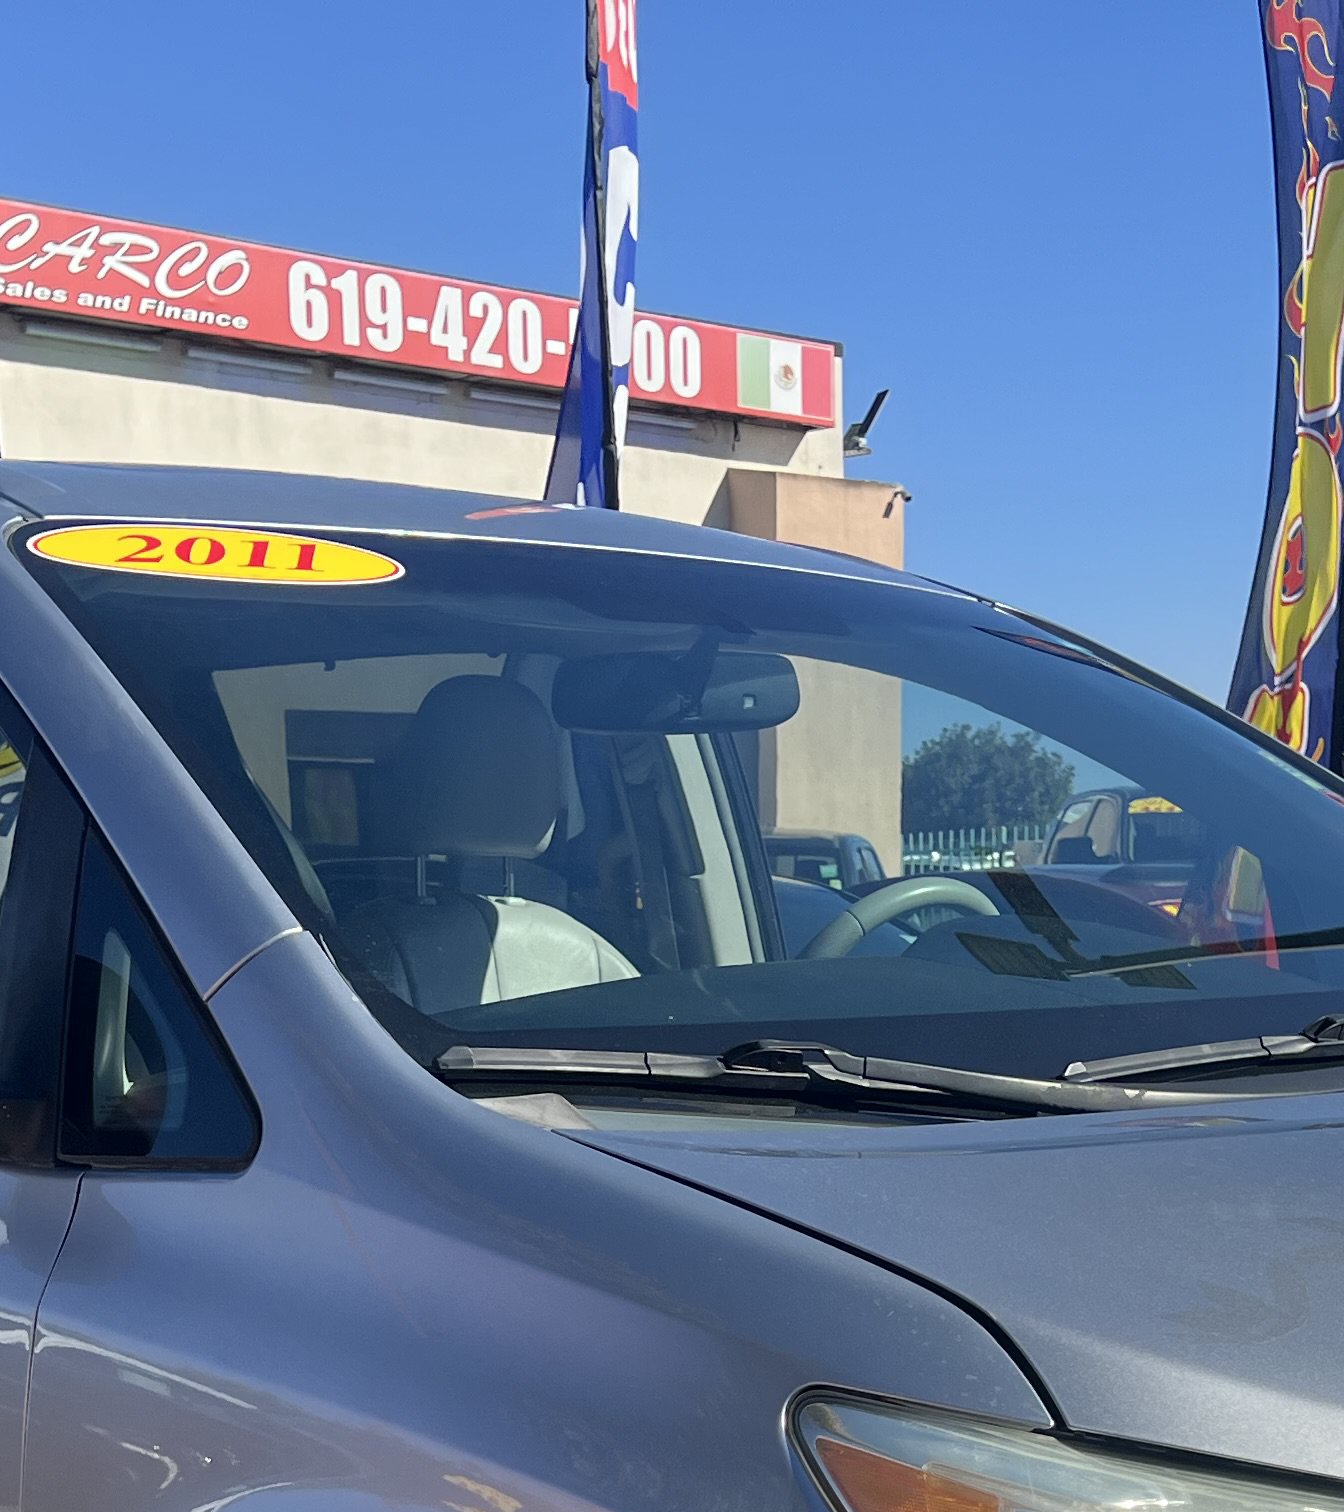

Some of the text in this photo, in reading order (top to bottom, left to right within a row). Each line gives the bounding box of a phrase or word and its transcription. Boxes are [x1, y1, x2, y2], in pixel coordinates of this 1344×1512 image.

[77, 292, 132, 313] and
[138, 296, 250, 330] Finance
[287, 259, 702, 399] 619-420-00
[114, 534, 325, 572] 2011
